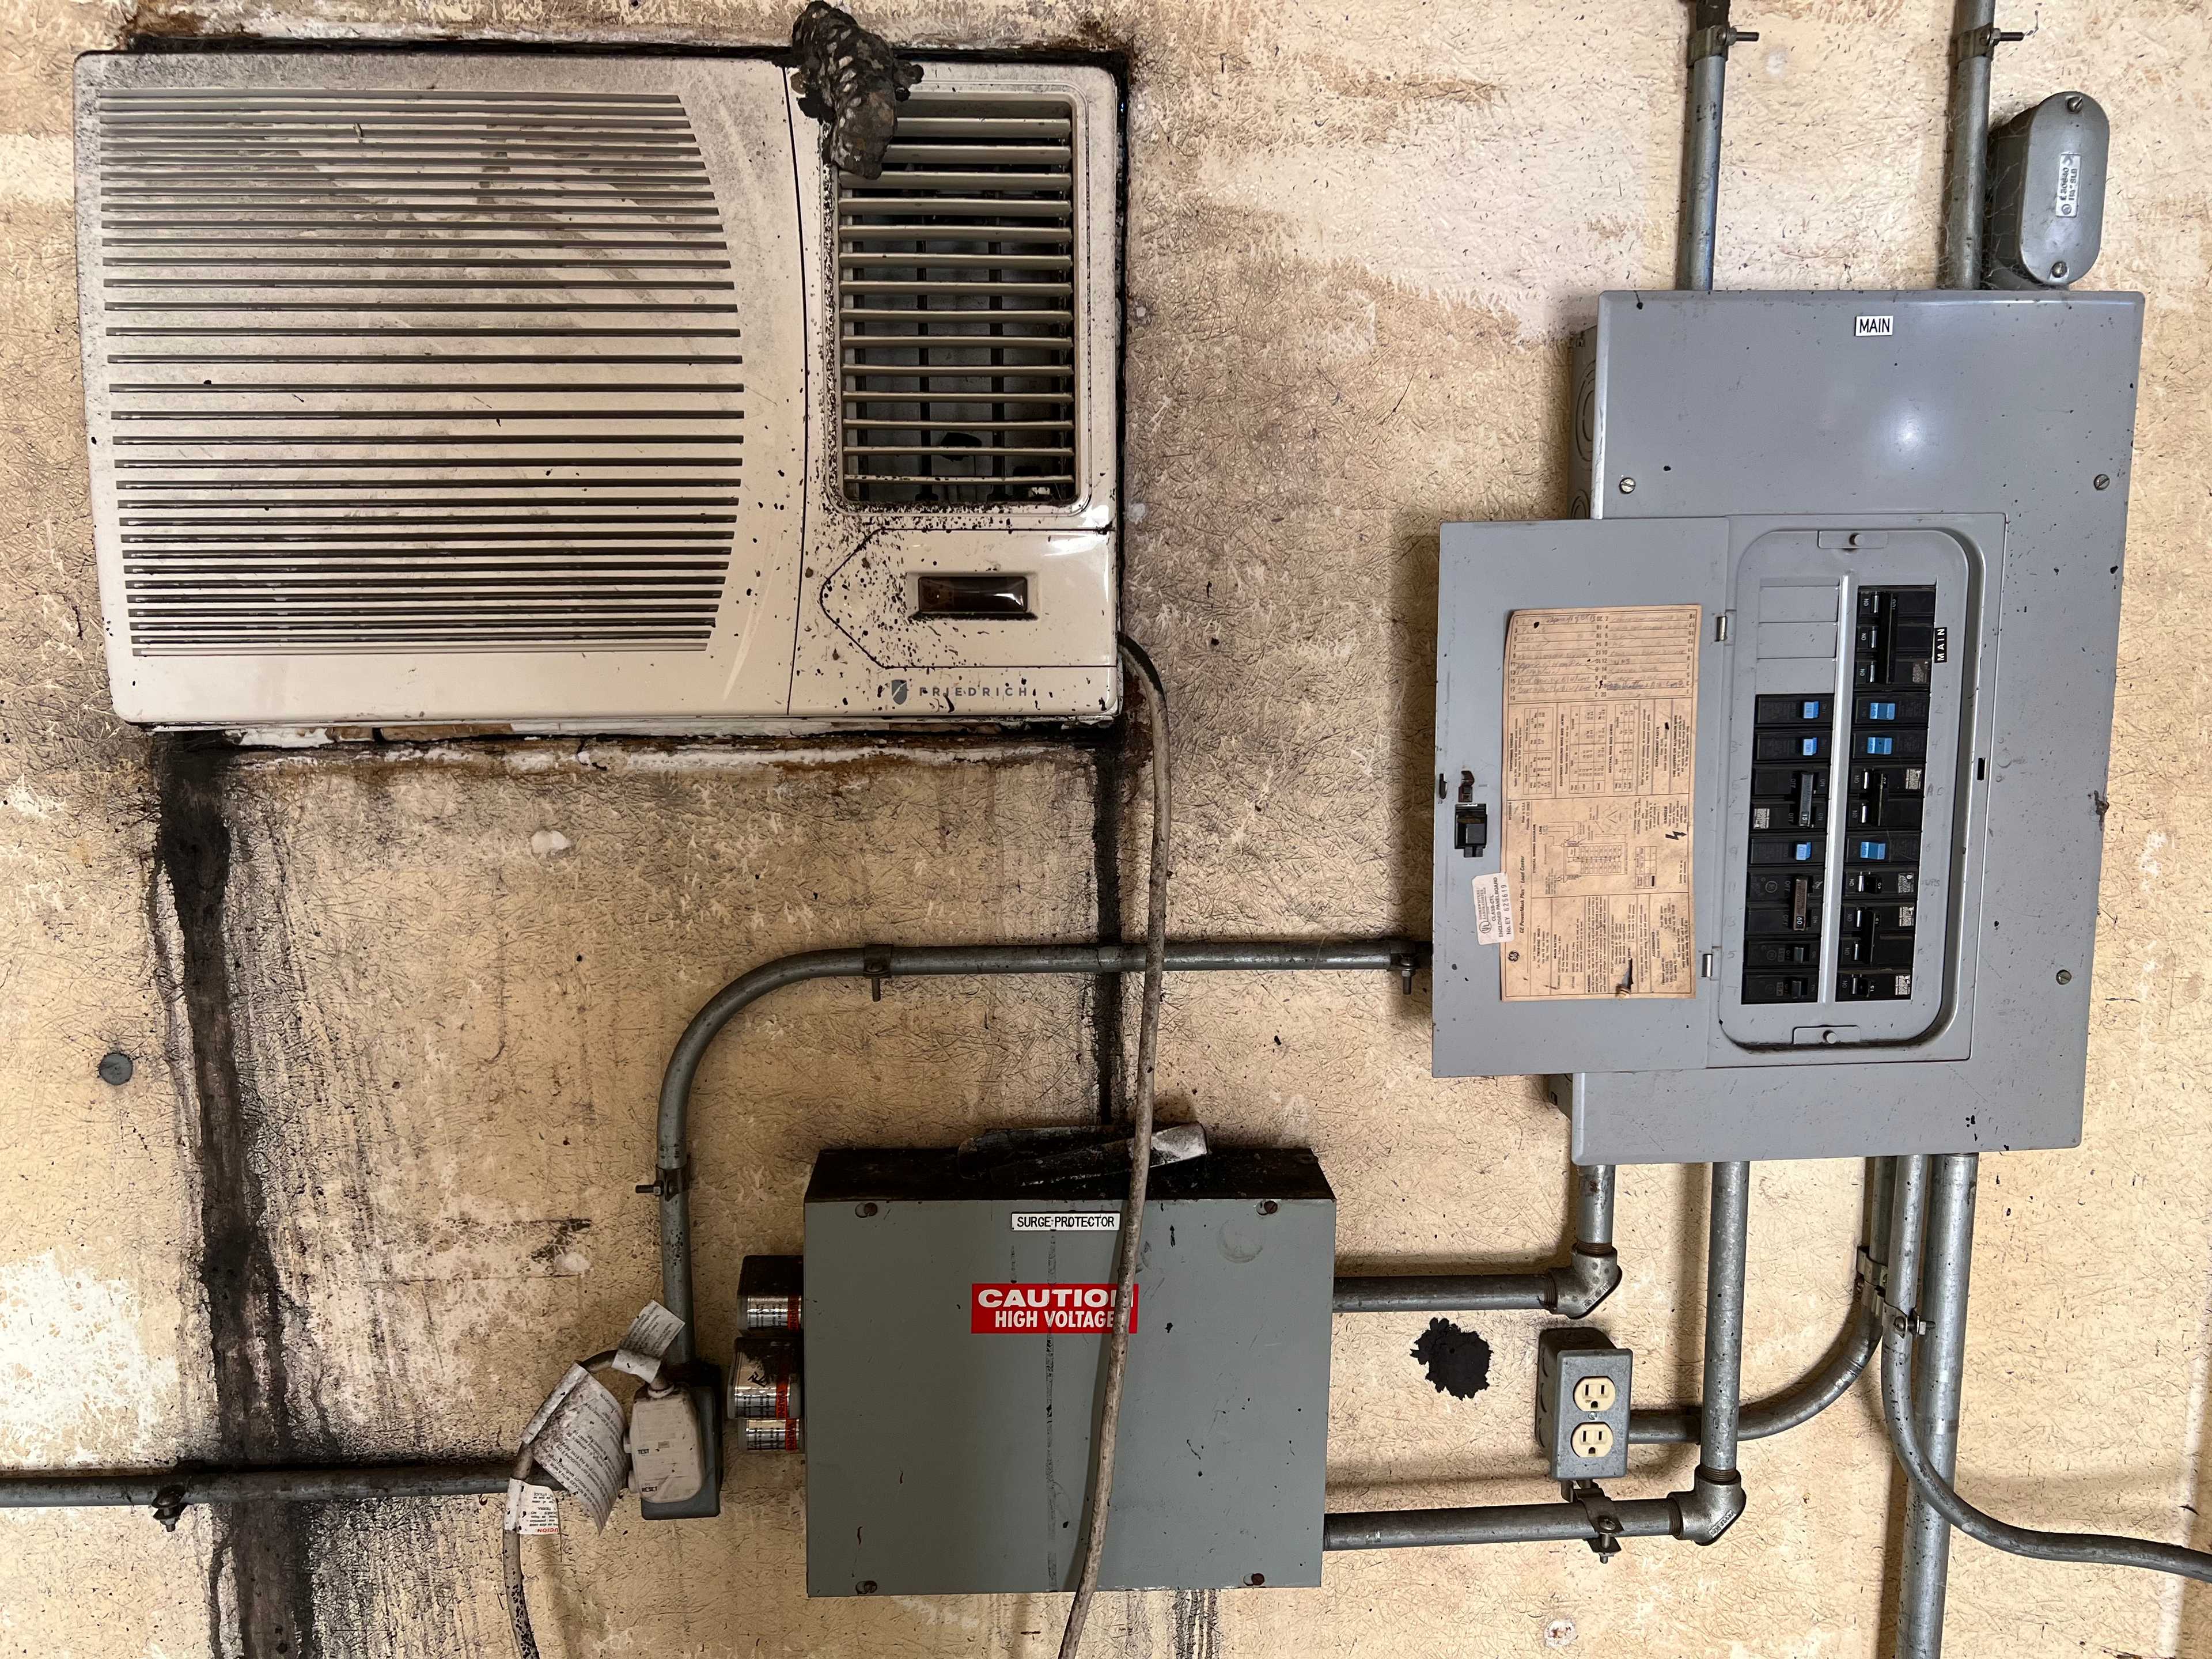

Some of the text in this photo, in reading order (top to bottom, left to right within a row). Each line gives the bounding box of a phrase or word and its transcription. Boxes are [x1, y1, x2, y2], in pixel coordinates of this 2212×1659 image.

[1860, 318, 1890, 333] MAIN
[919, 687, 1028, 697] FRIEDRICH
[1855, 775, 1859, 783] ON
[1853, 810, 1857, 818] ON
[1501, 885, 1510, 911] 625619
[1017, 1216, 1114, 1227] SURGE PROTECTOR
[995, 1310, 1114, 1328] HIGH VOLTAGE
